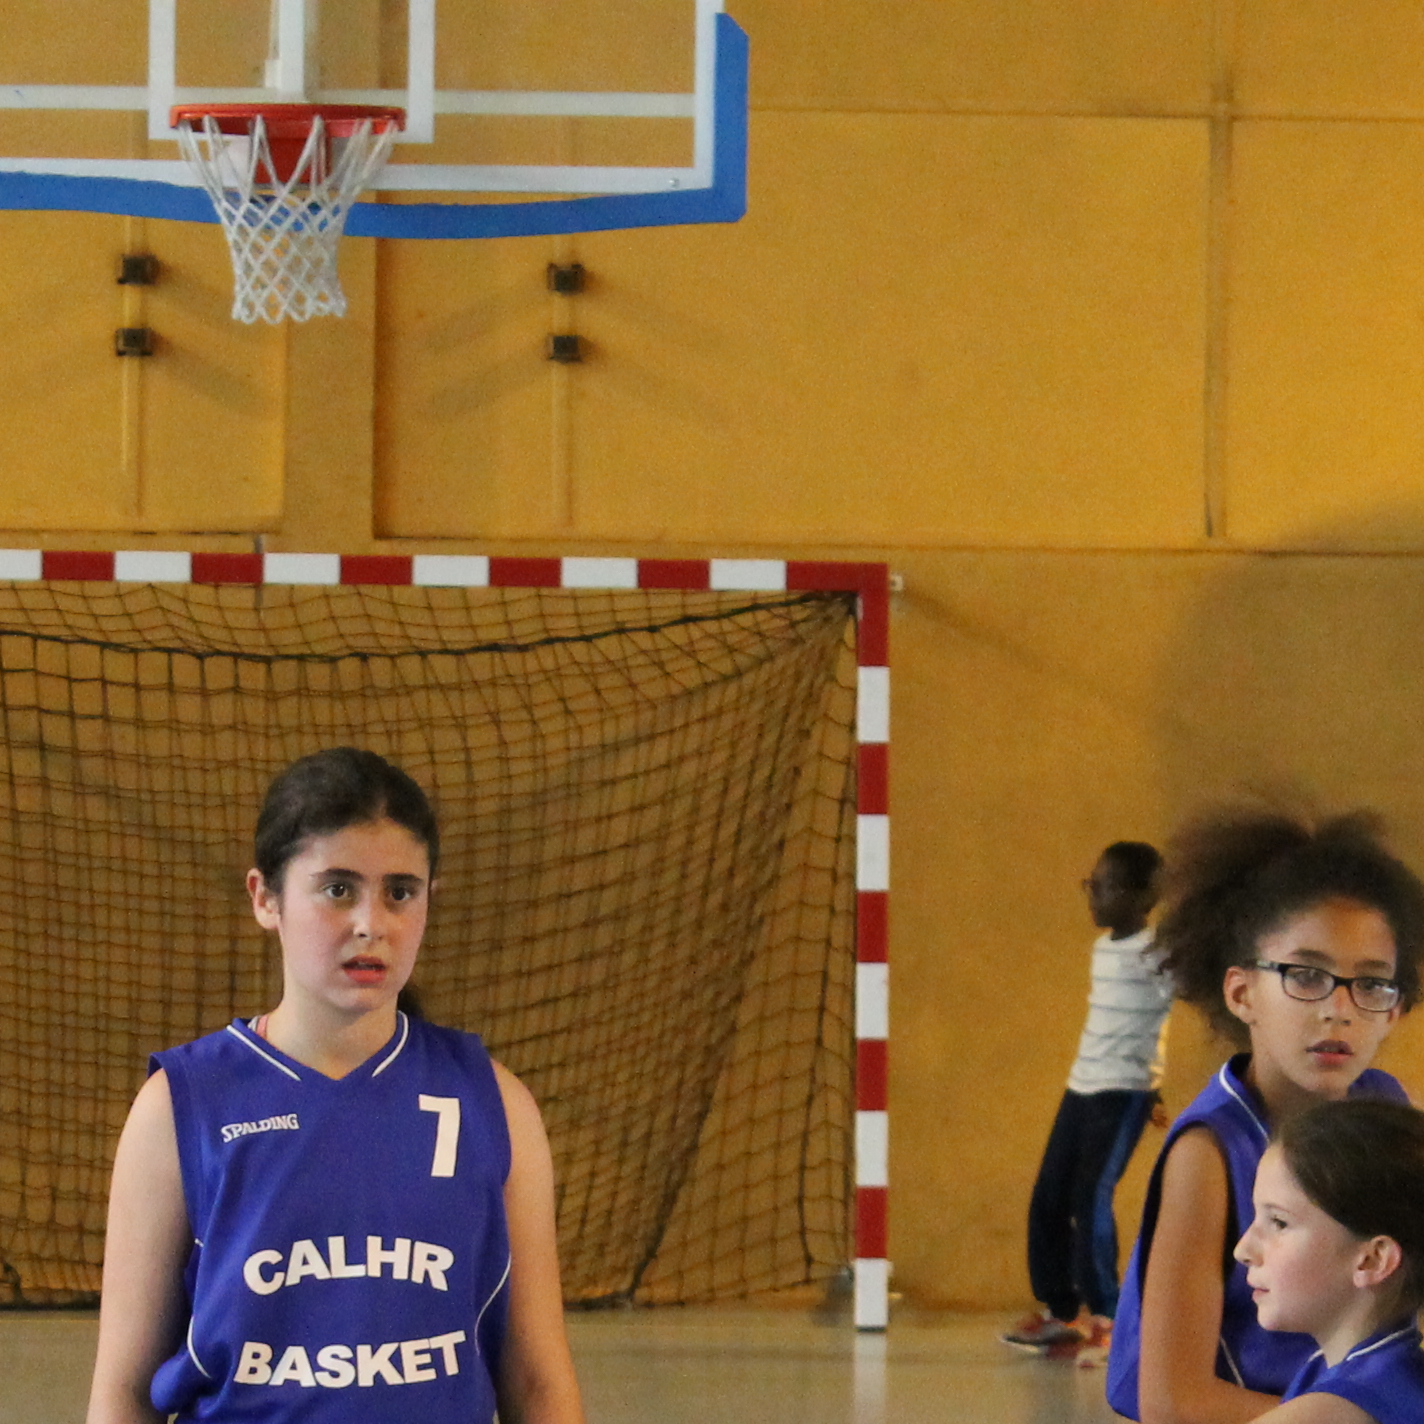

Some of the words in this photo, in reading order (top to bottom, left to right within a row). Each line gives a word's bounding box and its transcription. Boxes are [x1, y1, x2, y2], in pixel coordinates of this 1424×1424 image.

[220, 1113, 300, 1143] SPALDING
[418, 1093, 461, 1178] 7
[243, 1235, 455, 1295] CALHR
[233, 1330, 466, 1388] BASKET
